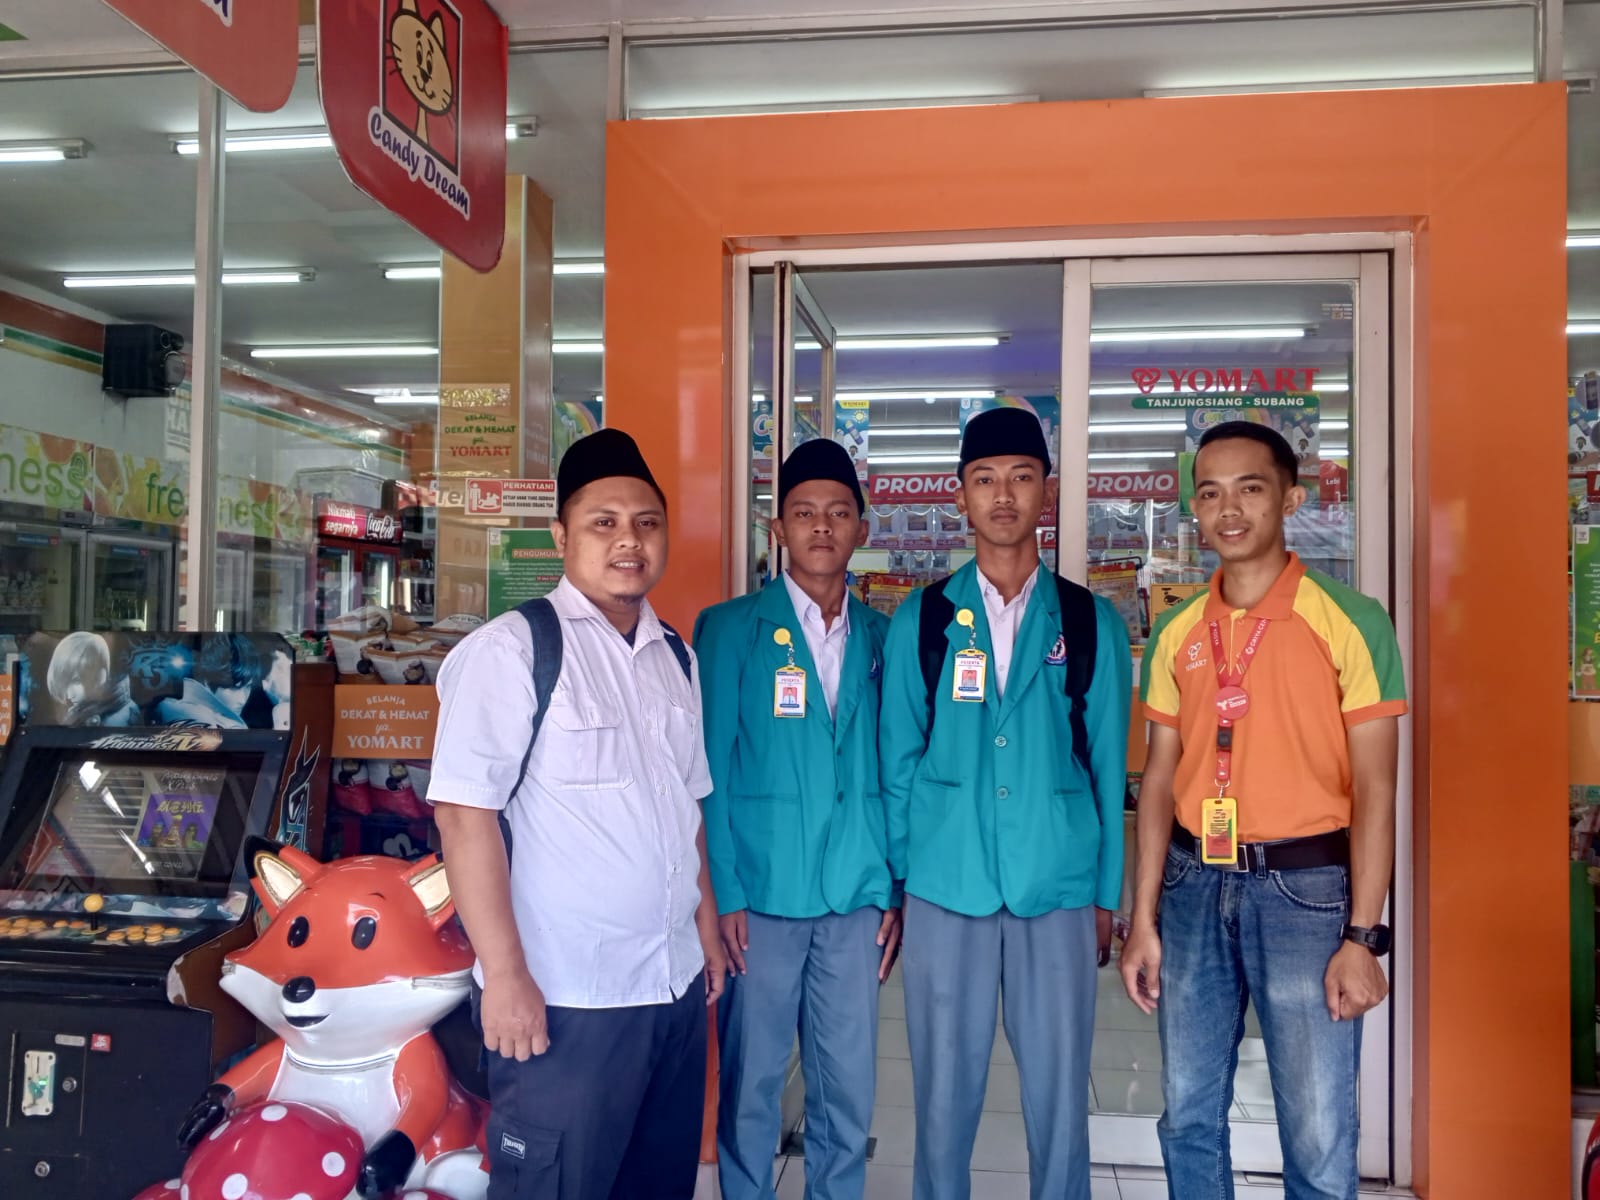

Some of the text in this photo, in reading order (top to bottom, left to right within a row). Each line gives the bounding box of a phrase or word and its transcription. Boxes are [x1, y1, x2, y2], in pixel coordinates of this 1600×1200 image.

[371, 113, 468, 215] Candy Dream
[1167, 367, 1321, 393] YOMART
[1146, 398, 1243, 407] TANJUNGSIANG
[1253, 397, 1305, 406] SUBANG
[484, 425, 516, 433] HEMAT
[450, 446, 511, 457] YOMART
[874, 476, 962, 494] PROMO
[366, 695, 406, 706] BELANJA
[341, 709, 430, 720] DEKAT & HEMAT
[347, 735, 425, 750] YOMART
